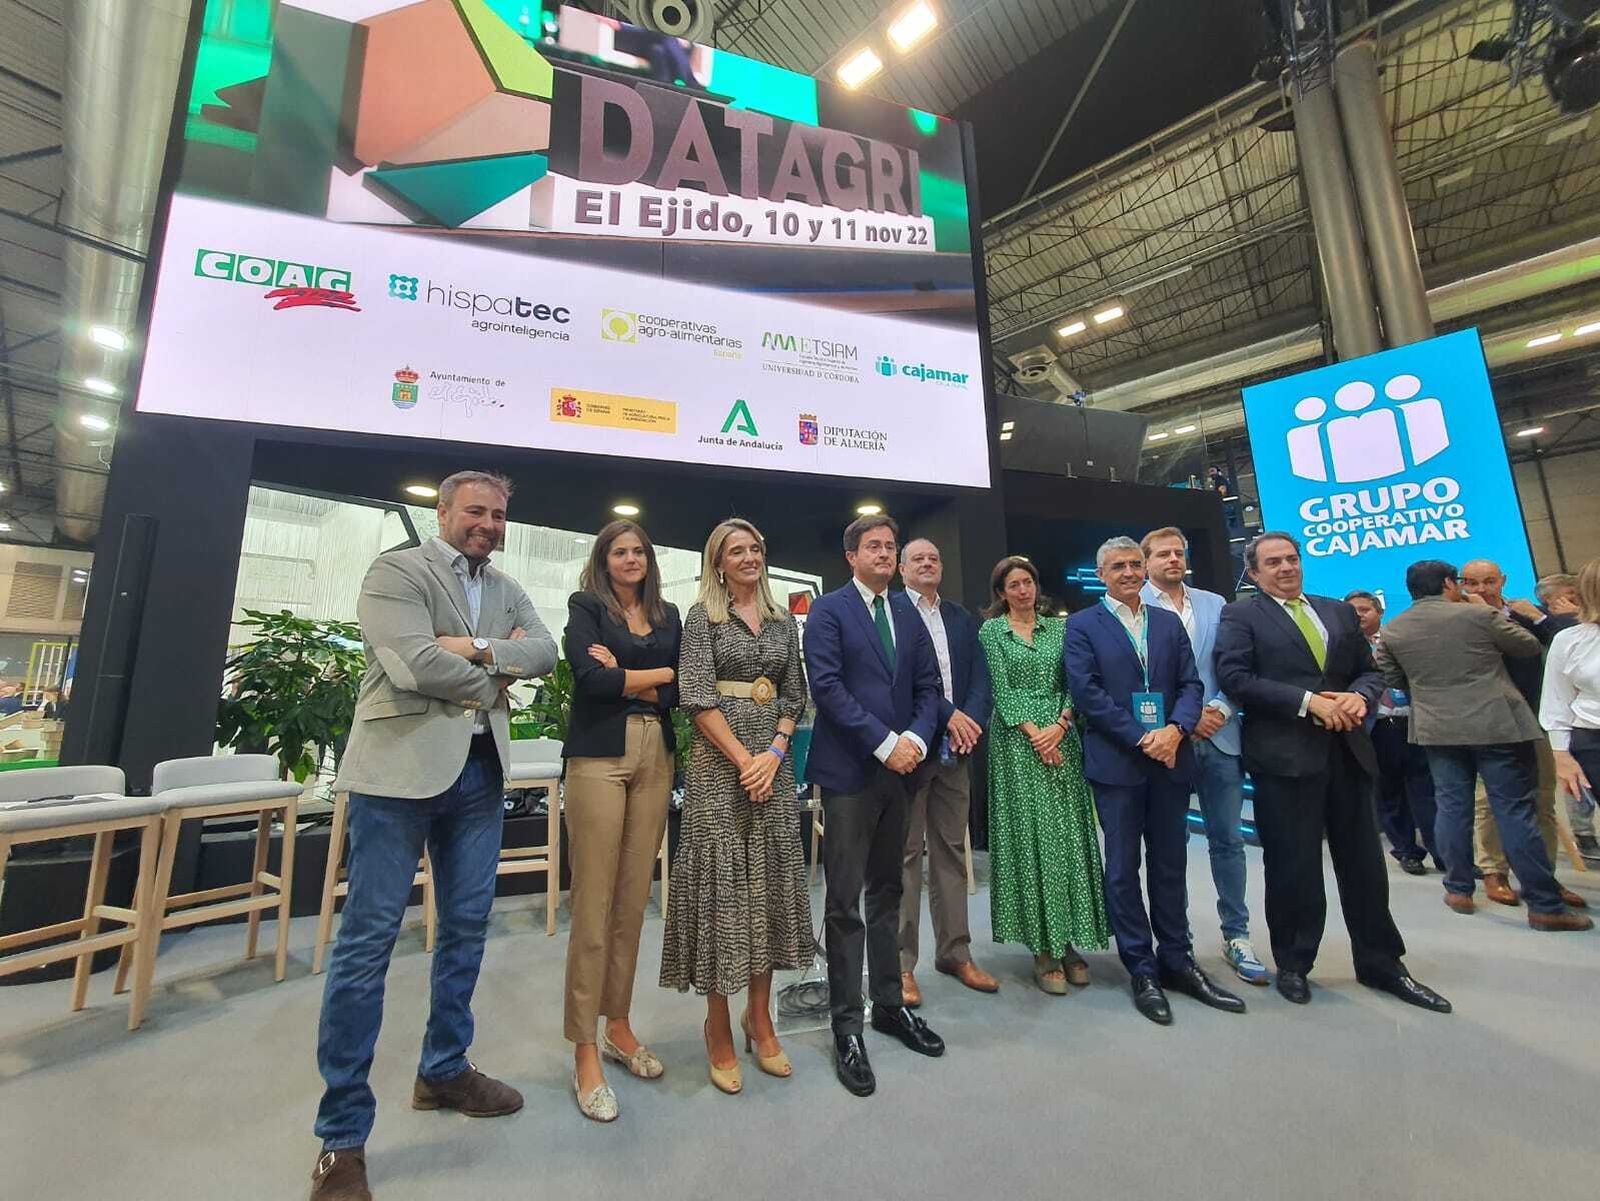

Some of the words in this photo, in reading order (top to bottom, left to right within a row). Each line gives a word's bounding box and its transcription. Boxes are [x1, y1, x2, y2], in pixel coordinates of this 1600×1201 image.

[578, 75, 923, 218] DATAGRI
[575, 189, 622, 226] El
[638, 194, 753, 237] Ejido,
[765, 209, 799, 236] 10
[808, 218, 823, 241] y
[830, 217, 857, 241] 11
[865, 222, 901, 244] nov
[906, 225, 928, 246] 22
[198, 250, 350, 293] COAG
[427, 279, 570, 324] hispatec
[471, 319, 570, 341] agrointeligencia
[638, 313, 717, 335] cooperativas
[638, 324, 743, 349] agro-alimentarias
[801, 336, 858, 361] ETSIAM
[430, 371, 490, 385] Ayuntamiento
[495, 379, 506, 387] de
[902, 363, 969, 385] cajamar
[698, 435, 724, 446] Junta
[726, 436, 738, 446] de
[739, 438, 783, 451] Andalucía
[823, 436, 839, 447] DE
[1300, 476, 1460, 522] GRUPO
[1303, 503, 1464, 537] COOPERATIVO
[1306, 519, 1471, 557] CAJAMAR
